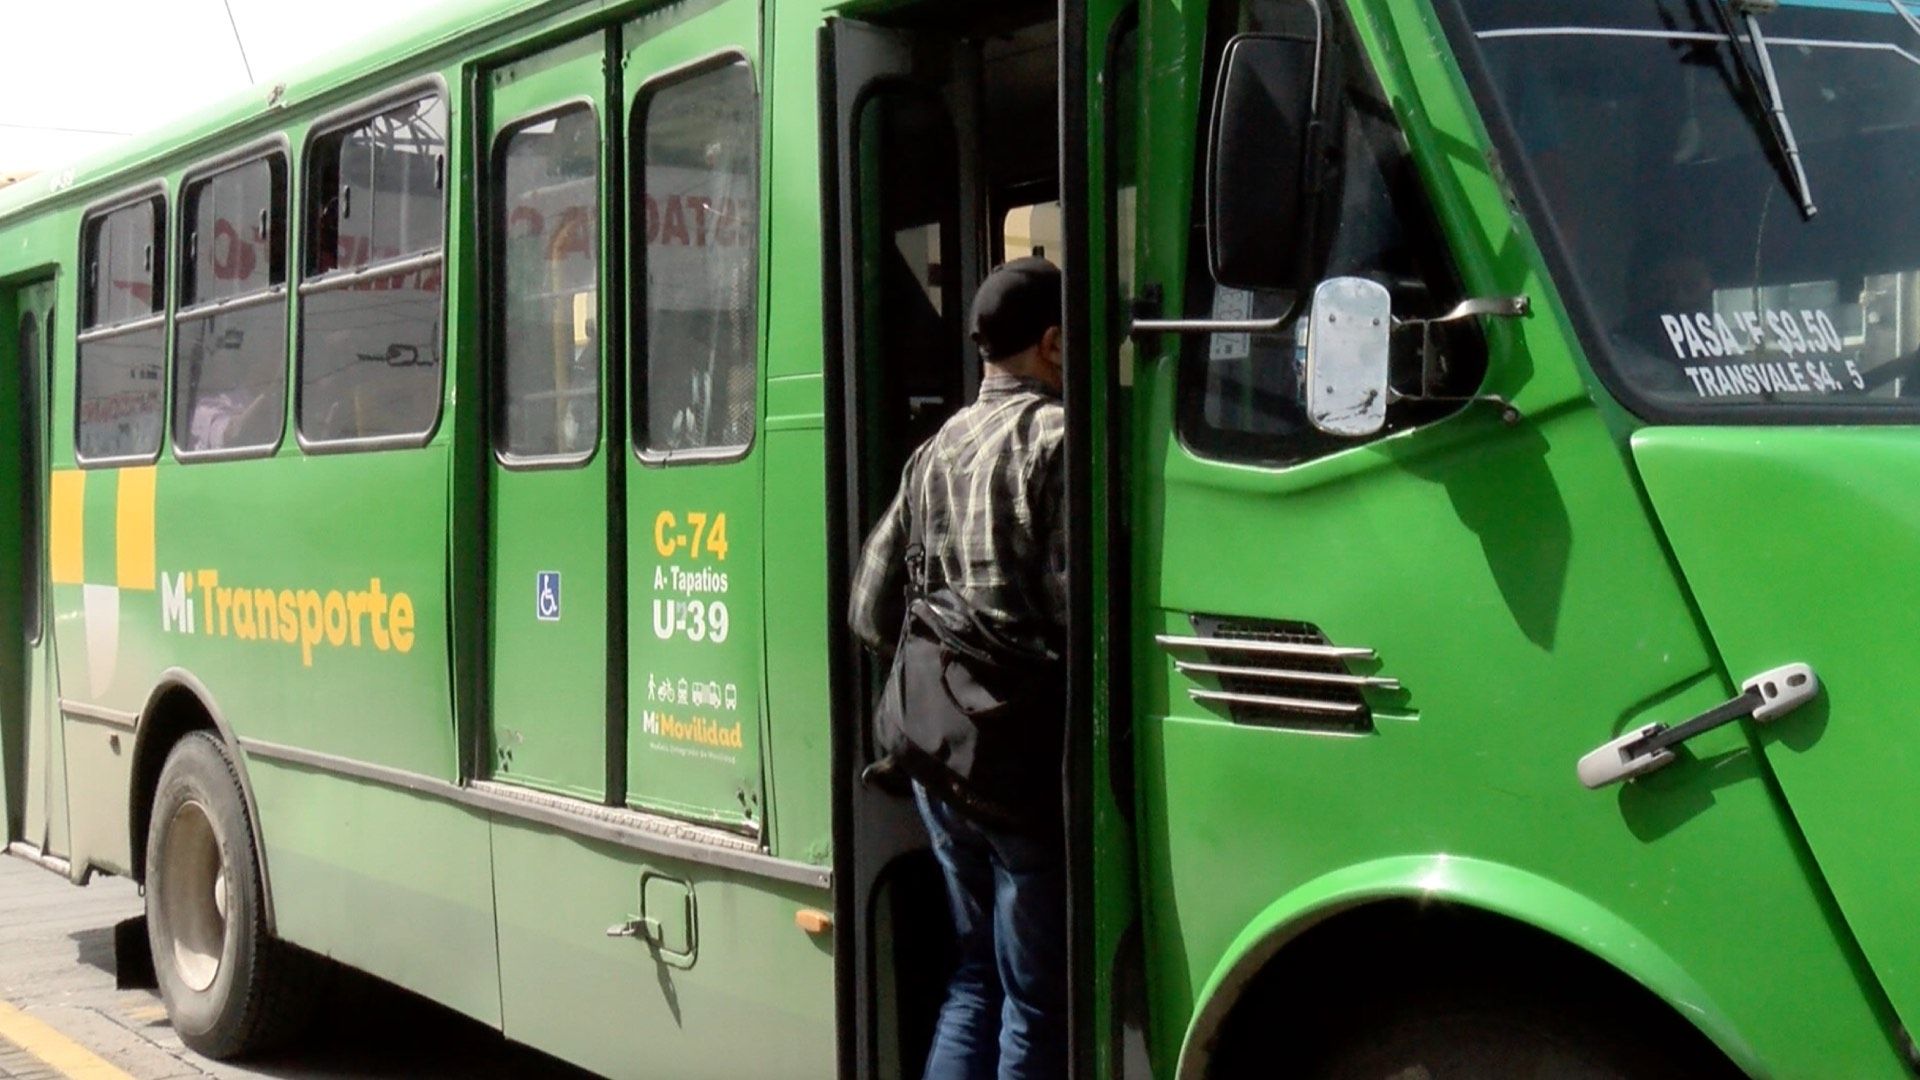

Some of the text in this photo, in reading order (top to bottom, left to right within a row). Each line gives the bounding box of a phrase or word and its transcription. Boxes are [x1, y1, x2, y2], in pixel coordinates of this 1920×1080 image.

[1766, 309, 1842, 358] $9.50
[1685, 362, 1810, 398] TRANSVALE
[654, 510, 729, 561] C-74
[670, 565, 729, 597] Tapatios
[161, 569, 415, 667] Mi Transporte
[653, 599, 729, 644] U-39
[643, 709, 743, 748] Mi Movilidad
